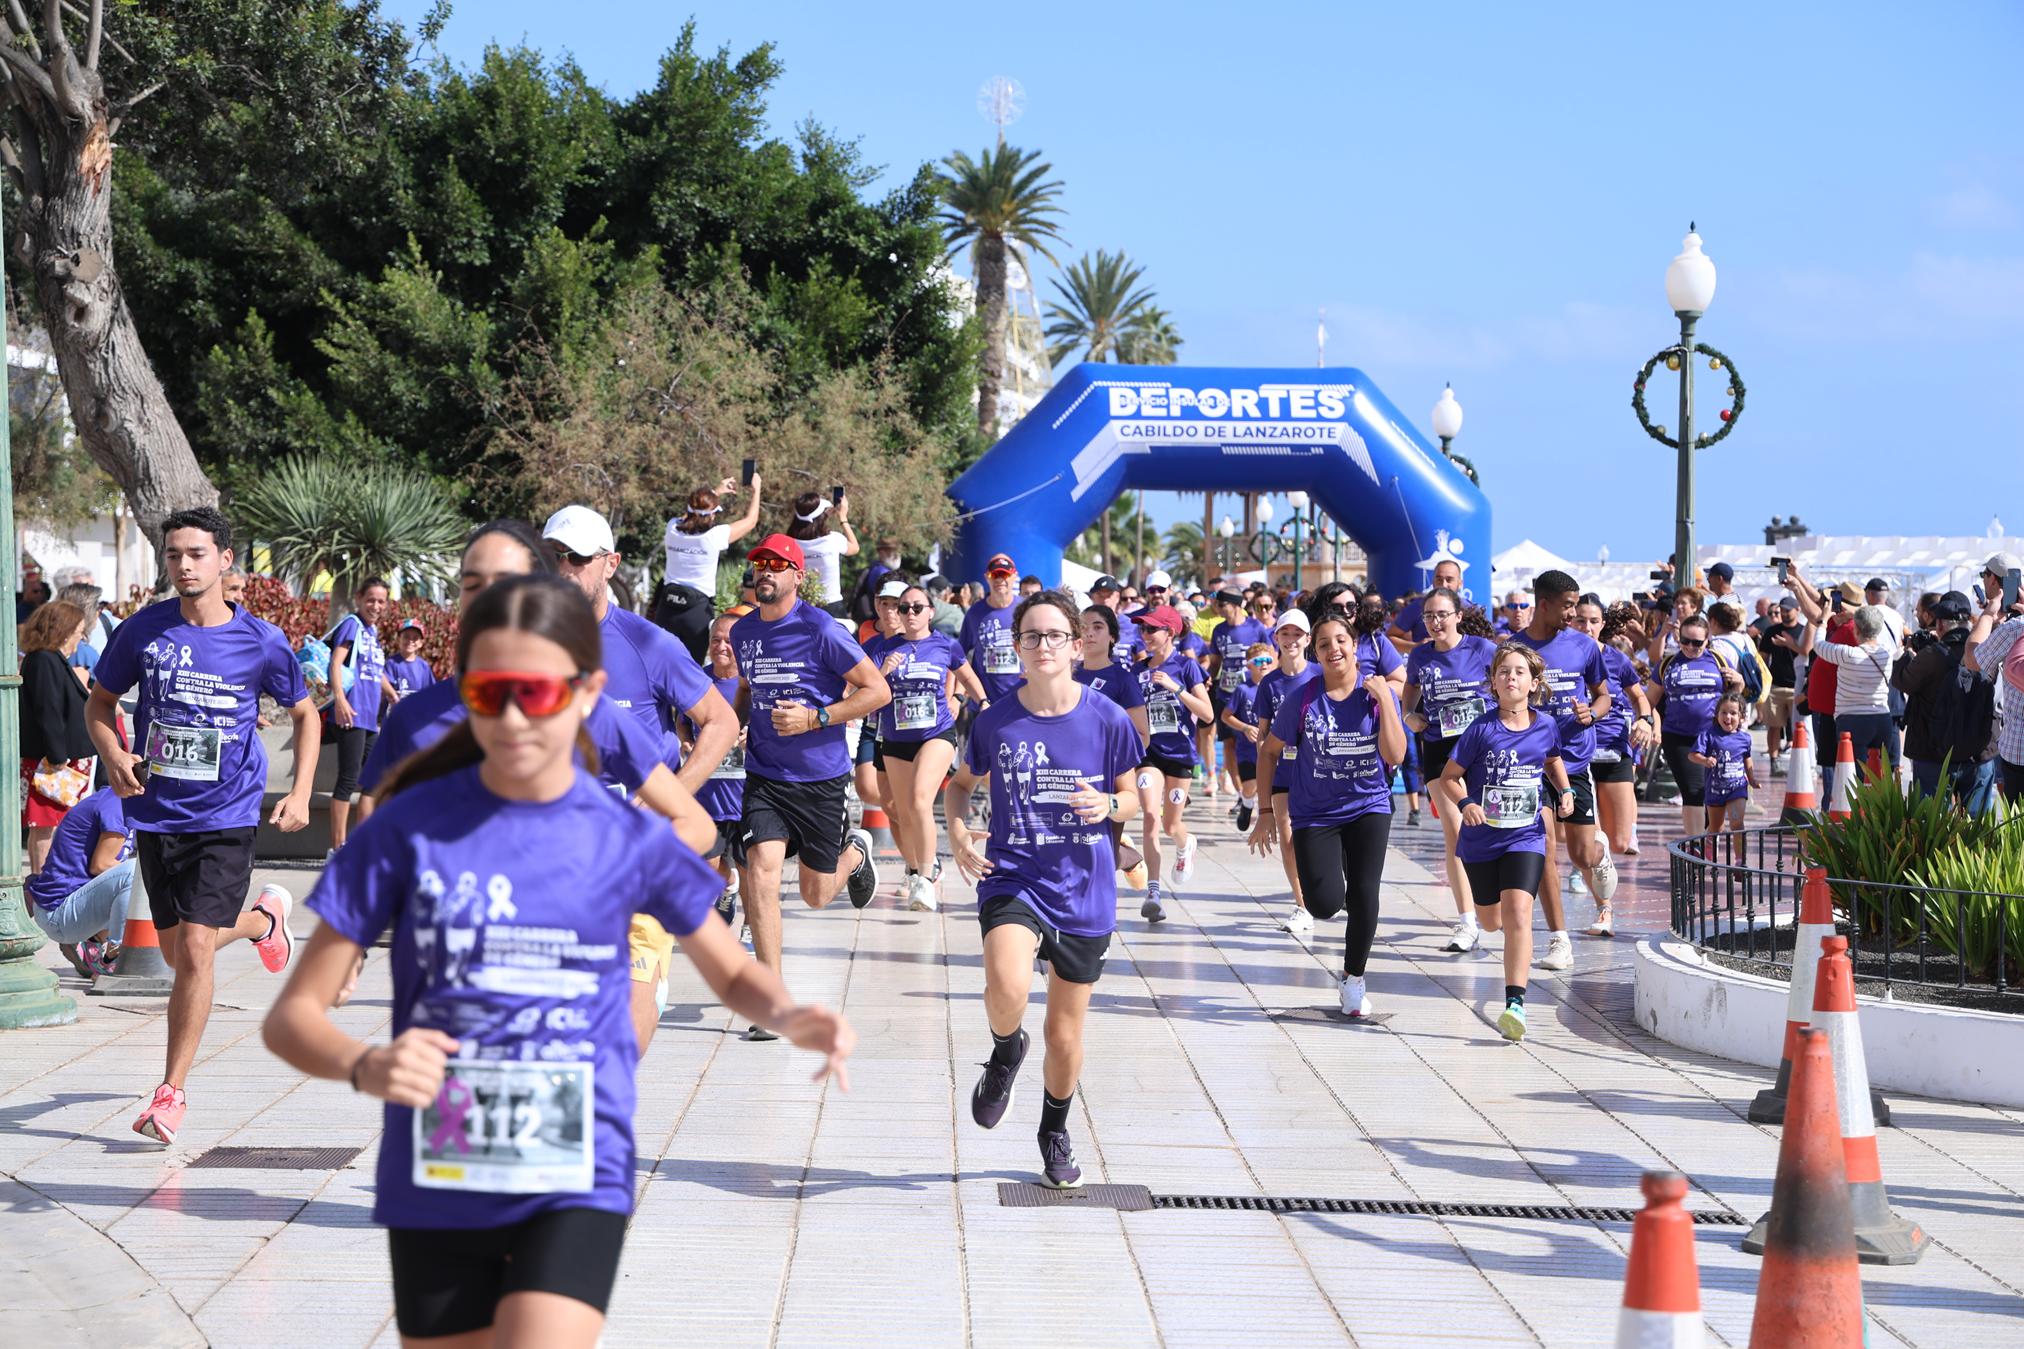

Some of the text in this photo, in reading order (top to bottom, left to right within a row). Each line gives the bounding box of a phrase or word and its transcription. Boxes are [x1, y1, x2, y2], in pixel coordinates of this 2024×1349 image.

[1109, 387, 1346, 419] DEPORTES
[1119, 424, 1337, 439] CABILDO DE LANZAROTE
[667, 594, 687, 605] FILA
[176, 677, 205, 687] CONTRA
[190, 672, 222, 682] CARRERA
[185, 684, 214, 695] GÉNERO
[905, 706, 925, 719] 016
[1452, 711, 1475, 725] 016
[161, 742, 199, 763] 016
[1047, 783, 1075, 791] GÉNERO
[1498, 799, 1524, 814] 112
[465, 1104, 543, 1147] 112
